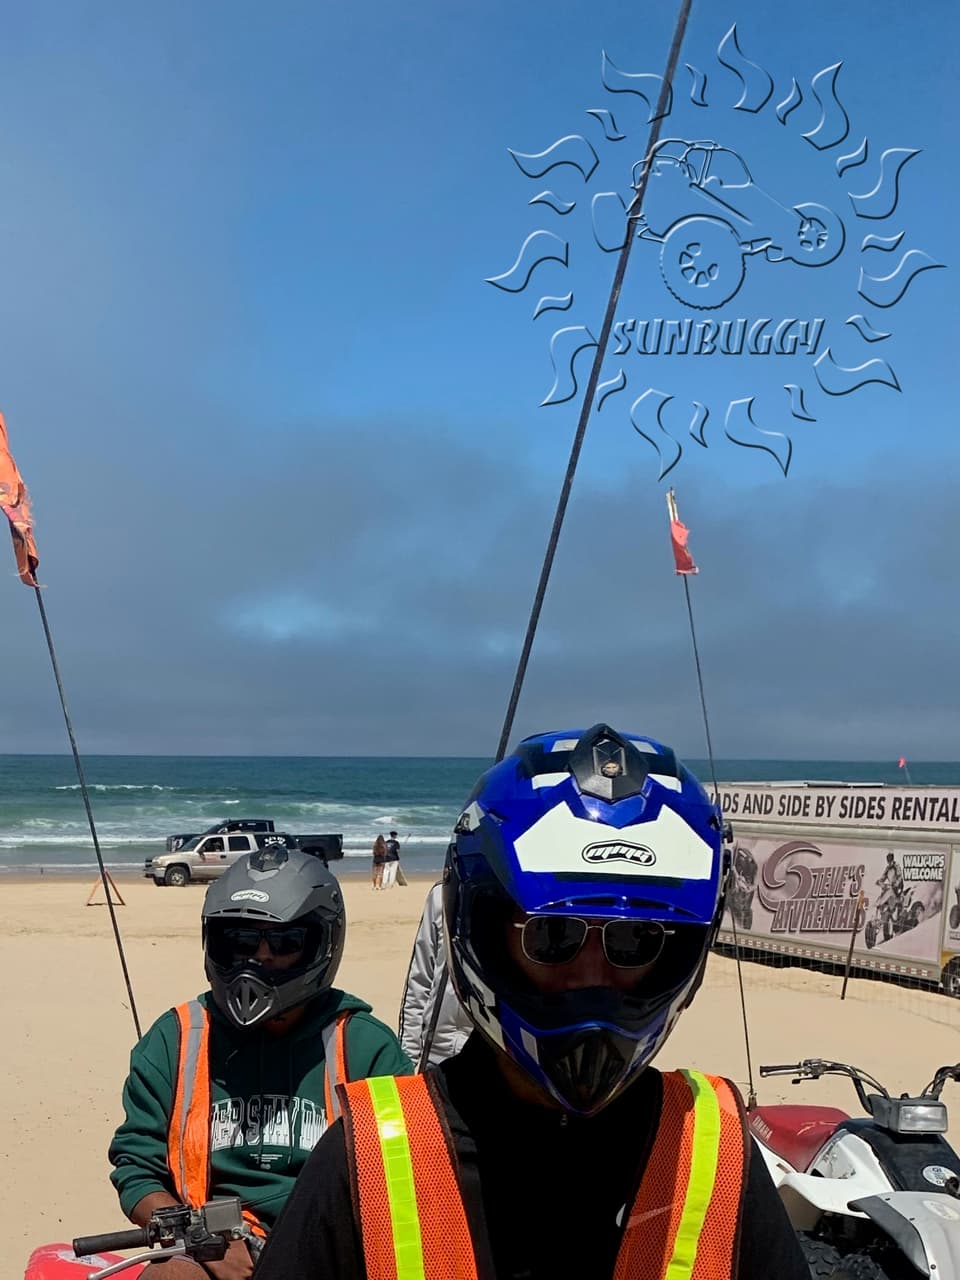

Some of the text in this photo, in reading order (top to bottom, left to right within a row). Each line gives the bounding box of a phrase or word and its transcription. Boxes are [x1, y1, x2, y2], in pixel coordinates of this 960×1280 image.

[742, 793, 774, 815] AND
[777, 794, 810, 817] SIDE
[815, 795, 833, 818] BY
[838, 795, 886, 820] SIDES
[902, 854, 945, 868] WALK-UPS
[902, 868, 943, 881] WELCOME
